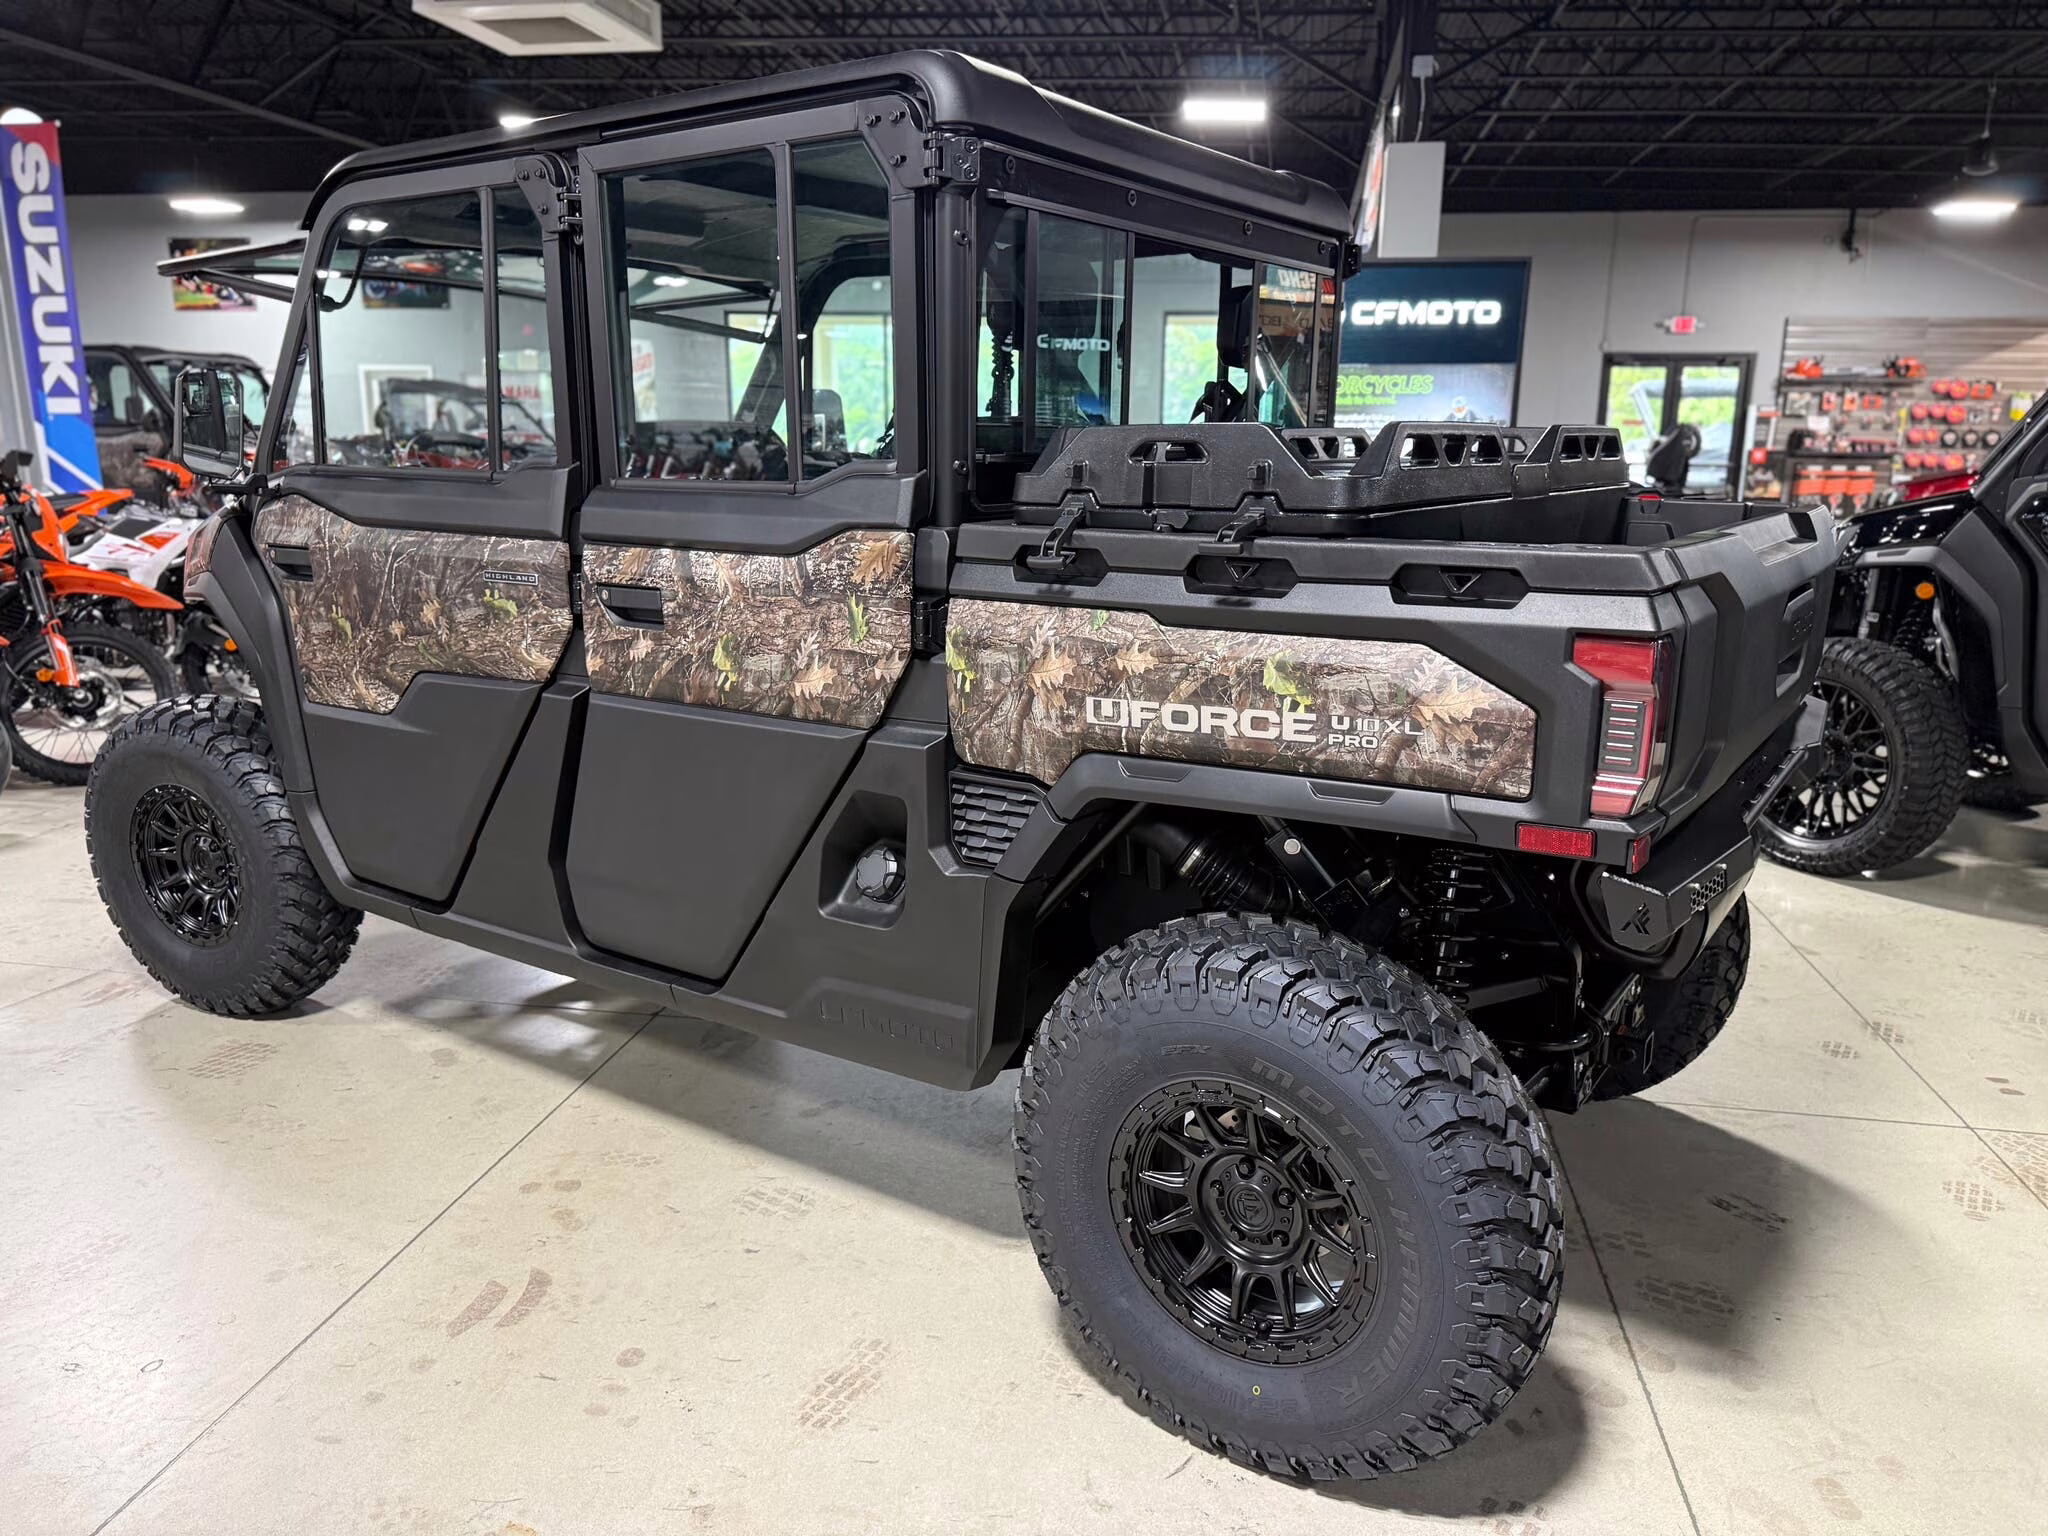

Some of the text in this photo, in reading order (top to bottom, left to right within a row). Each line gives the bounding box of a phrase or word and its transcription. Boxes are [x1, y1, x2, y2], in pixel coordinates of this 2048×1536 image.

[10, 141, 82, 414] SUZUKI
[1351, 300, 1502, 326] CFMOTO
[1336, 374, 1435, 395] ORCYCLES
[484, 572, 536, 582] HIGHLAND
[1328, 733, 1379, 749] PRO
